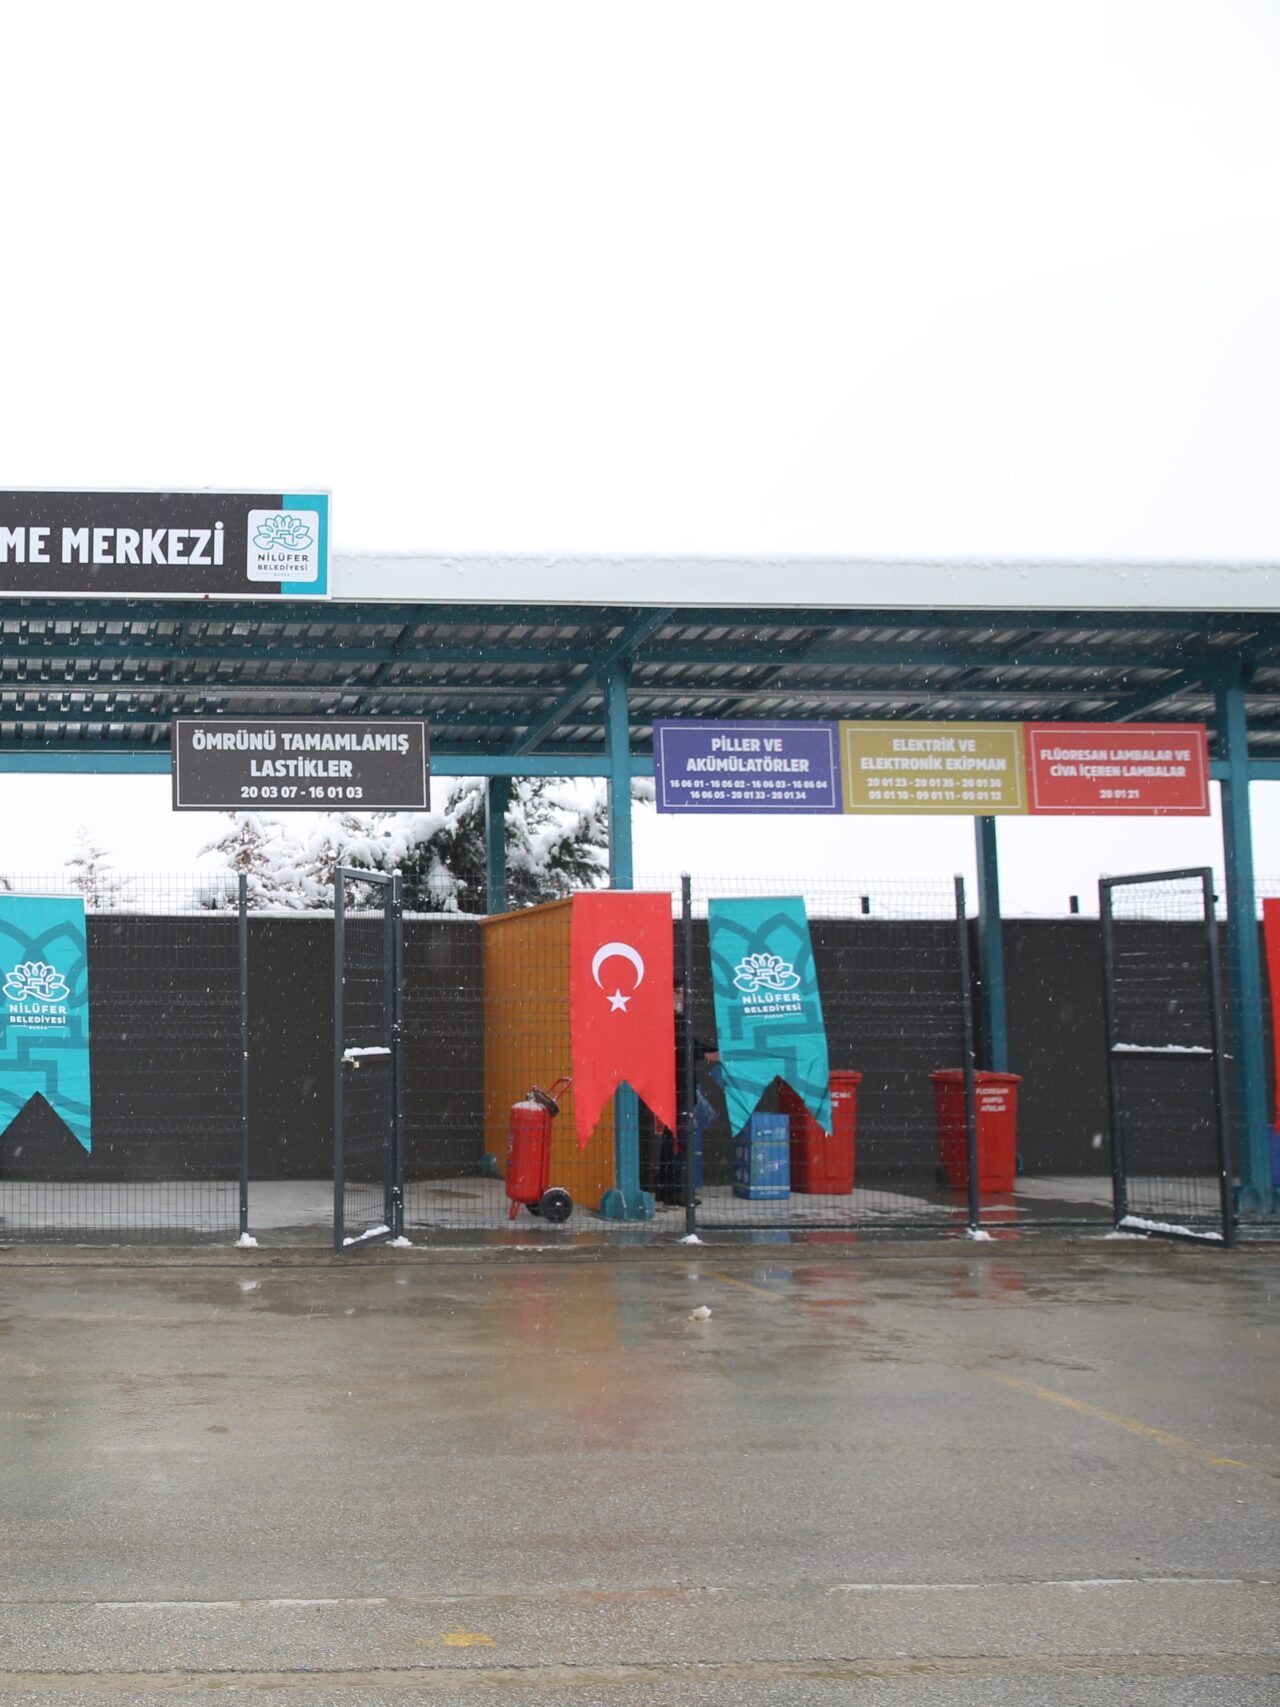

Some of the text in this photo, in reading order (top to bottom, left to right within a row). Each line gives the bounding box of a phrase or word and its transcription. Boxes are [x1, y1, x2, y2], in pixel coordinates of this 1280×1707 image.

[61, 520, 225, 566] MERKEZİ
[257, 552, 309, 562] NİLÜFER
[257, 563, 308, 571] BELEDİYESİ
[192, 729, 410, 755] ÖMRÜNÜ TAMAMLAMIŞ
[712, 734, 782, 752] PİLLER VE
[893, 737, 976, 753] ELEKTRİK VE
[1110, 749, 1173, 762] LAMBALAR
[1175, 749, 1190, 762] VE
[250, 756, 353, 778] LASTİKLER
[687, 755, 809, 773] AKÜMÜLATÖRLER
[861, 755, 1006, 771] ELEKTRONİK EKİPMAN
[1050, 763, 1186, 780] CİVA İÇEREN LAMBALAR
[670, 779, 680, 788] 16
[681, 779, 692, 788] 06
[694, 779, 703, 788] 01
[711, 779, 720, 788] 16
[722, 779, 733, 789] 06
[734, 779, 745, 789] 02
[752, 779, 761, 789] 16
[763, 779, 774, 789] 06
[775, 780, 786, 789] 03
[793, 780, 802, 789] 16
[804, 780, 815, 789] 06
[816, 780, 827, 789] 04
[240, 785, 259, 799] 20
[260, 785, 278, 799] 03
[280, 785, 298, 799] 07
[308, 786, 325, 799] 16
[326, 786, 343, 799] 01
[345, 786, 363, 799] 03
[690, 790, 700, 799] 16
[702, 790, 713, 799] 06
[714, 790, 725, 800] 05
[731, 790, 742, 800] 20
[744, 790, 754, 800] 01
[755, 790, 765, 800] 33
[772, 791, 783, 800] 20
[784, 791, 794, 800] 01
[795, 791, 806, 800] 34
[741, 992, 802, 1004] NİLÜFER
[9, 1002, 68, 1014] NİLÜFER
[743, 1002, 802, 1014] BELEDİYESİ
[9, 1015, 66, 1024] BELEDİYESİ
